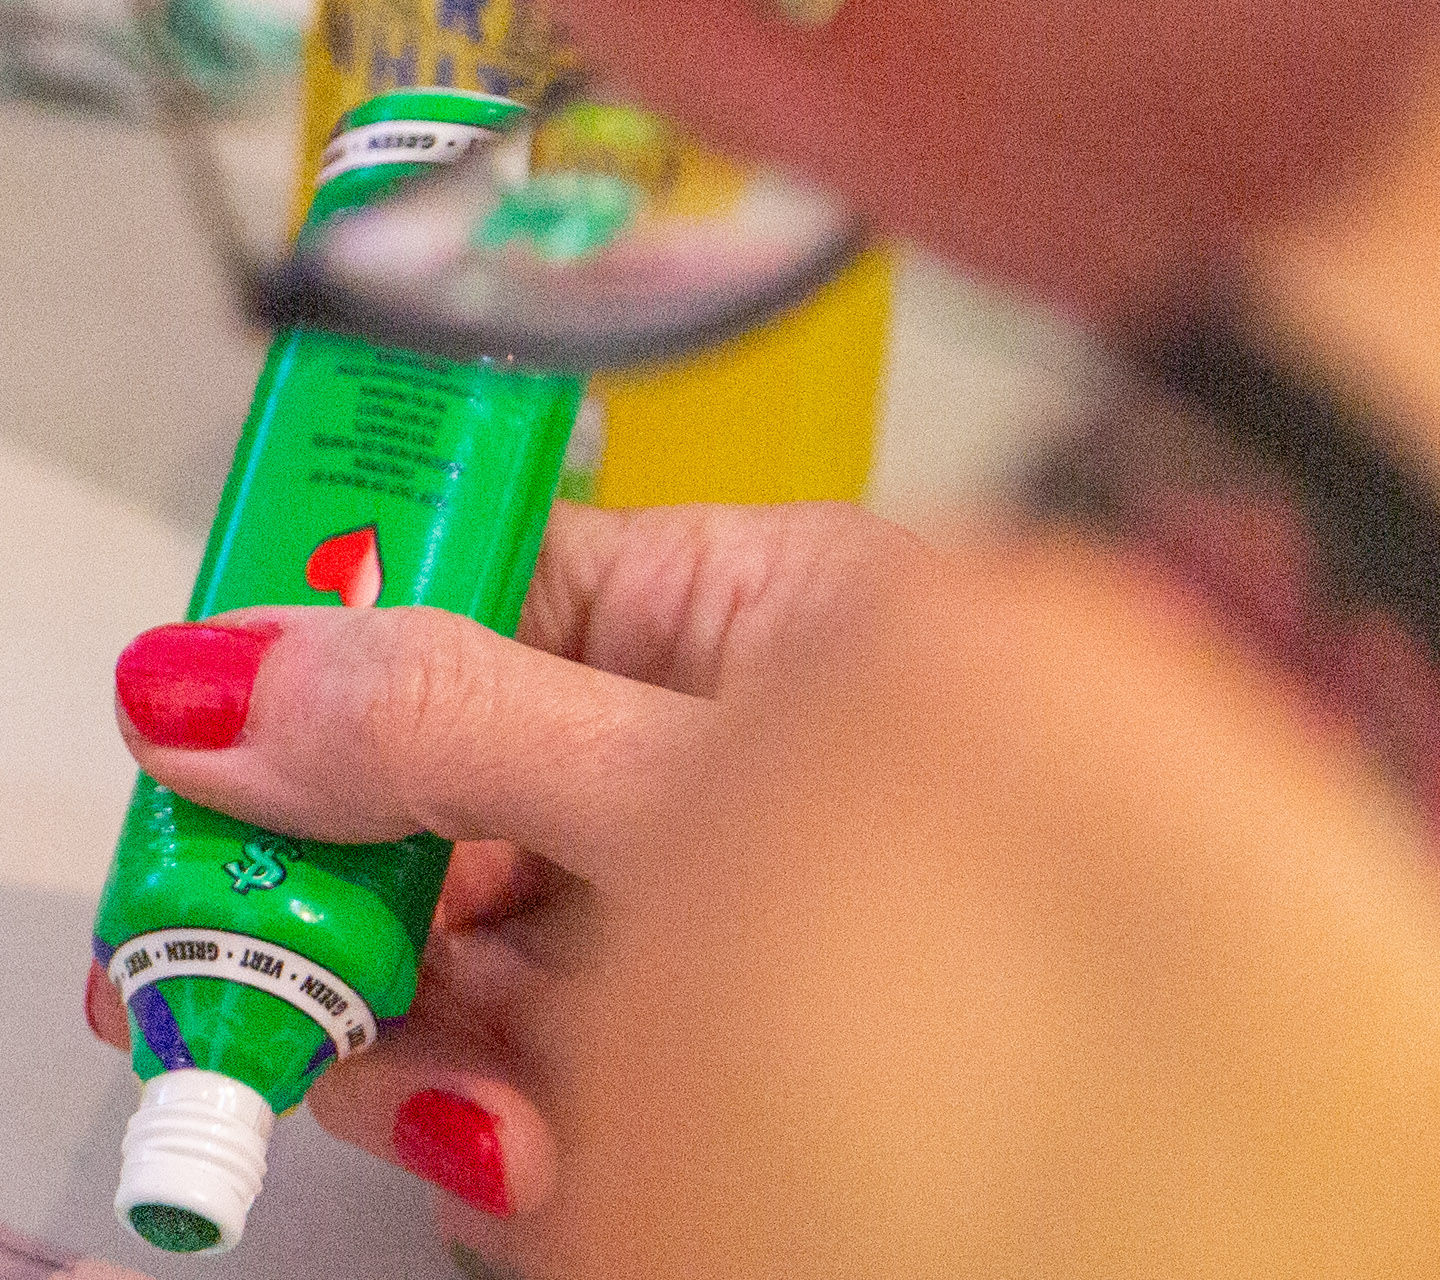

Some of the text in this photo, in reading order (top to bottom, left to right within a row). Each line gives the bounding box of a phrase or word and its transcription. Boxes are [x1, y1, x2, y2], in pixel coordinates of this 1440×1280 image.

[163, 939, 221, 963] GREEN
[238, 946, 285, 980] VERT
[299, 973, 351, 1018] GREEN
